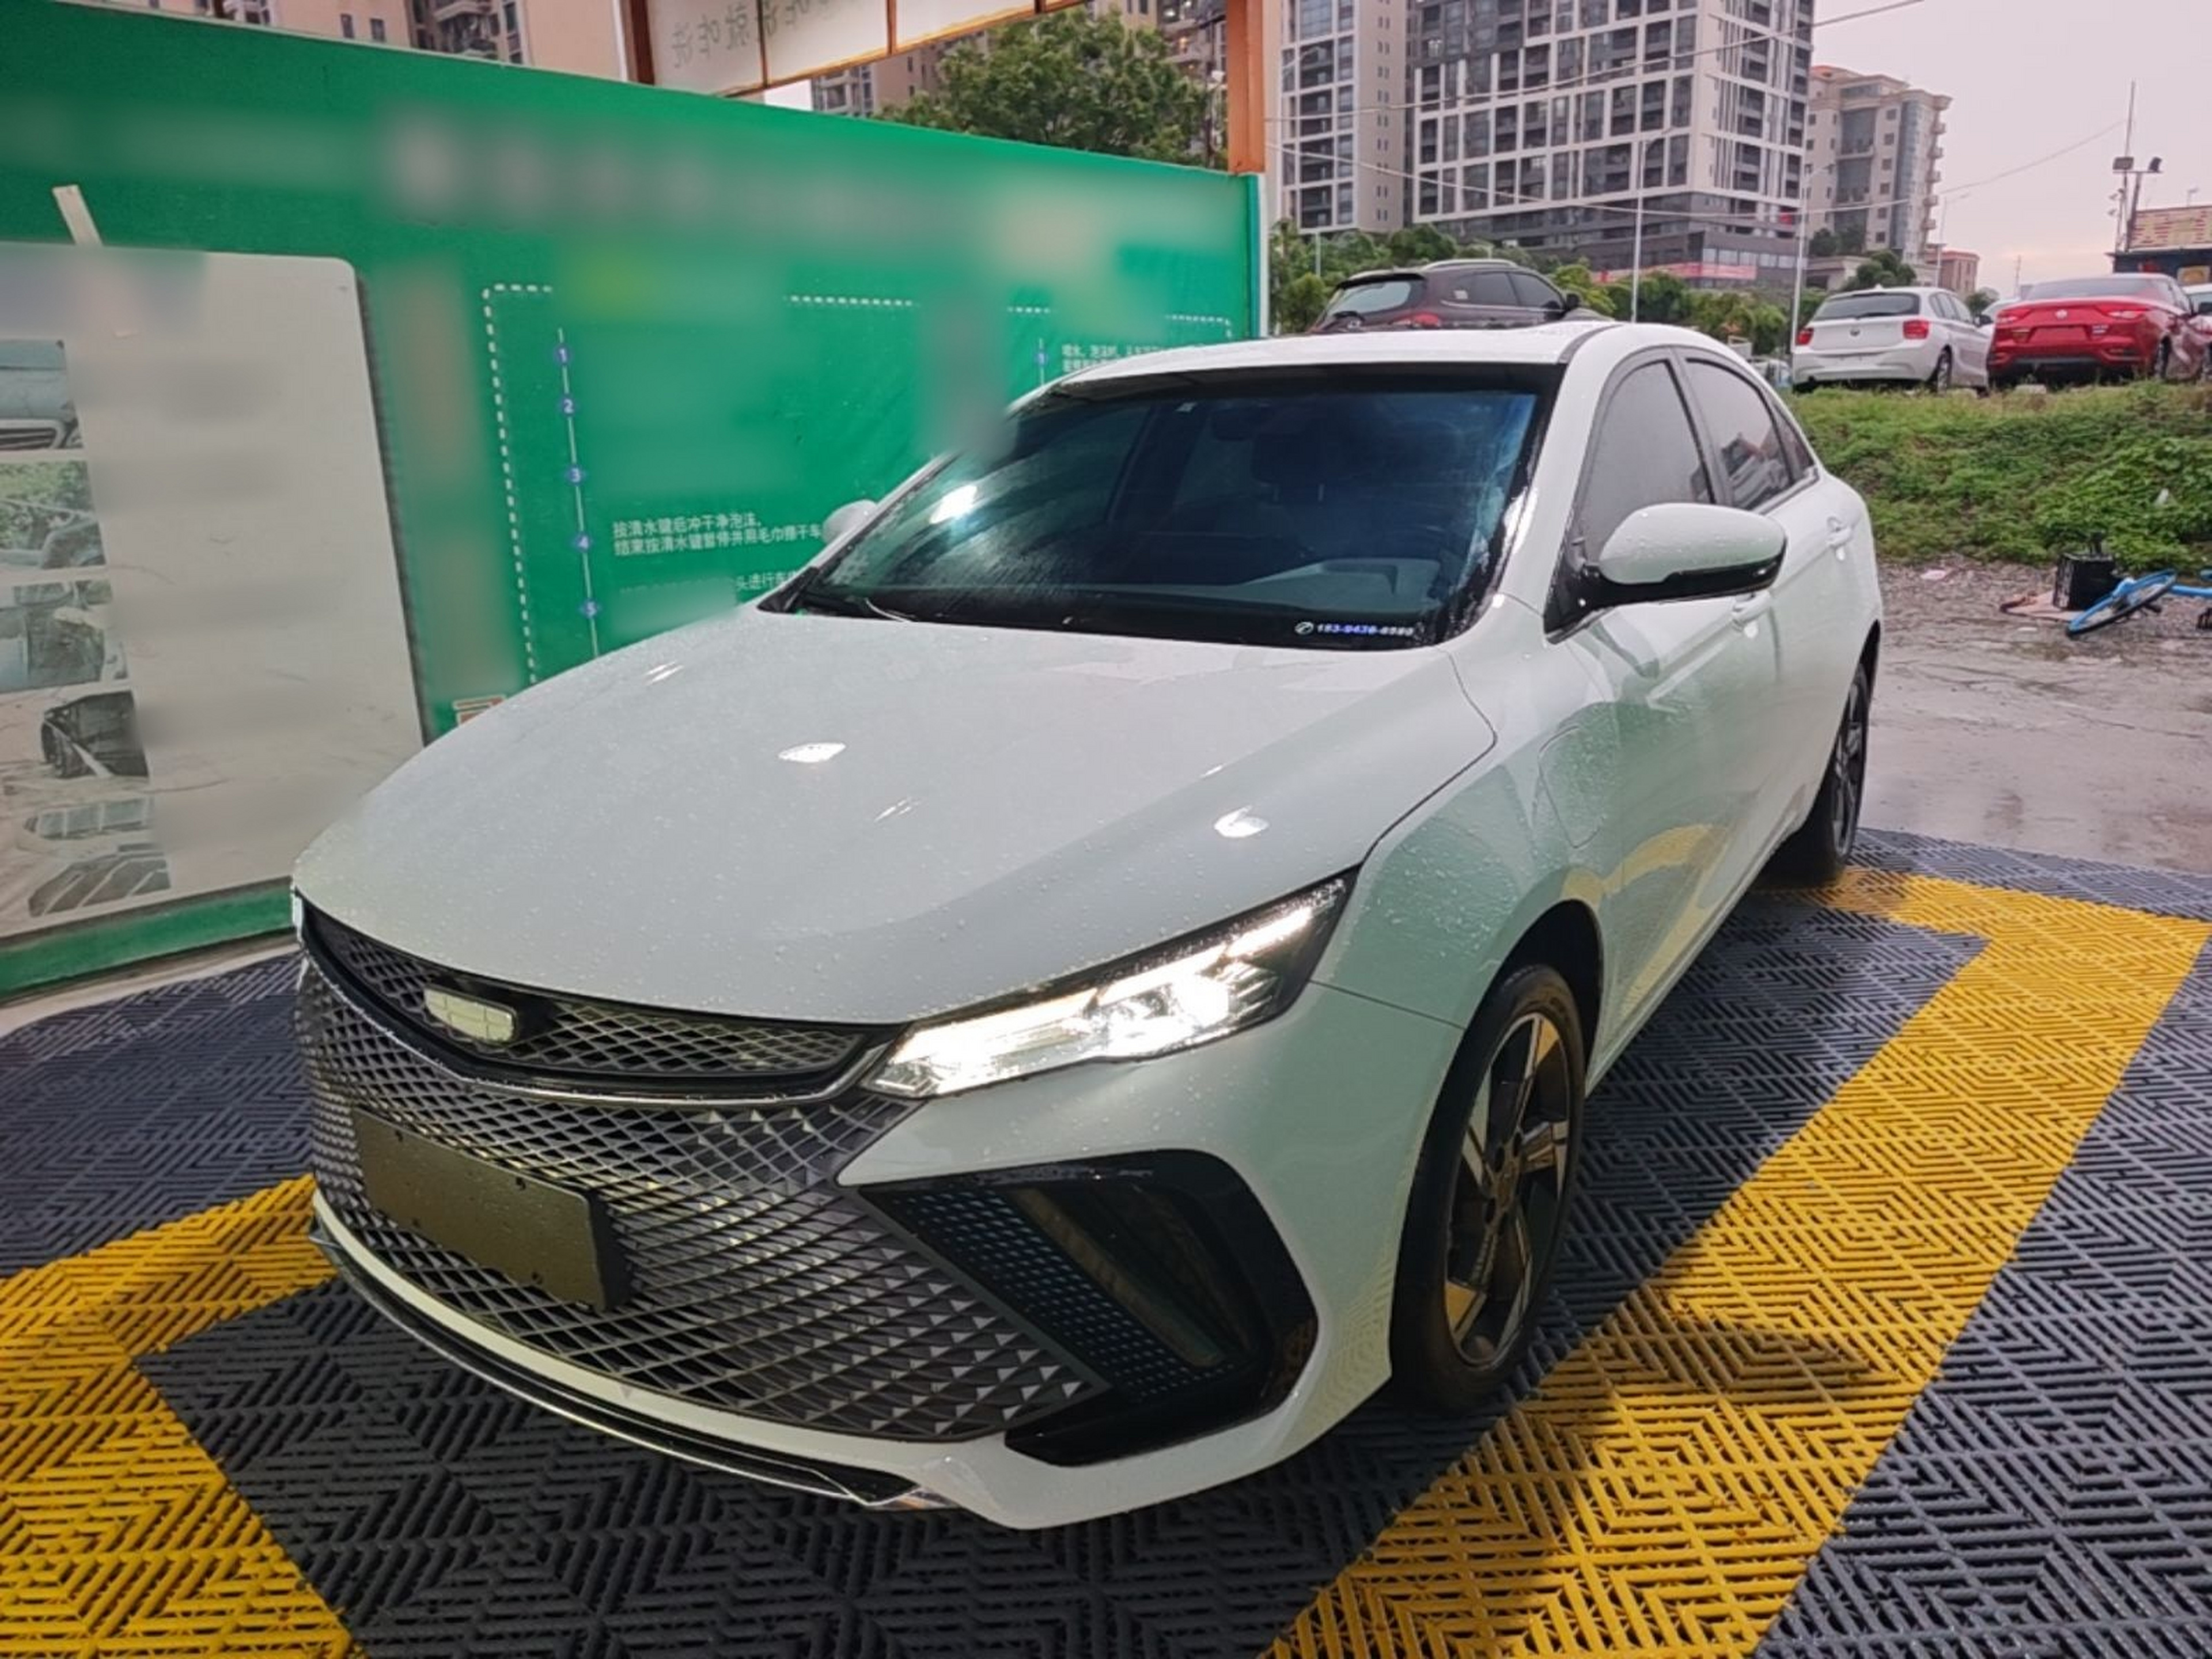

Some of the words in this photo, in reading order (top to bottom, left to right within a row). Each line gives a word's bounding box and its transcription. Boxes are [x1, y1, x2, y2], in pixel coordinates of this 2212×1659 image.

[558, 347, 567, 362] 1
[562, 398, 574, 414] 2
[569, 467, 581, 482] 3
[577, 536, 590, 549] 4
[586, 602, 598, 618] 5
